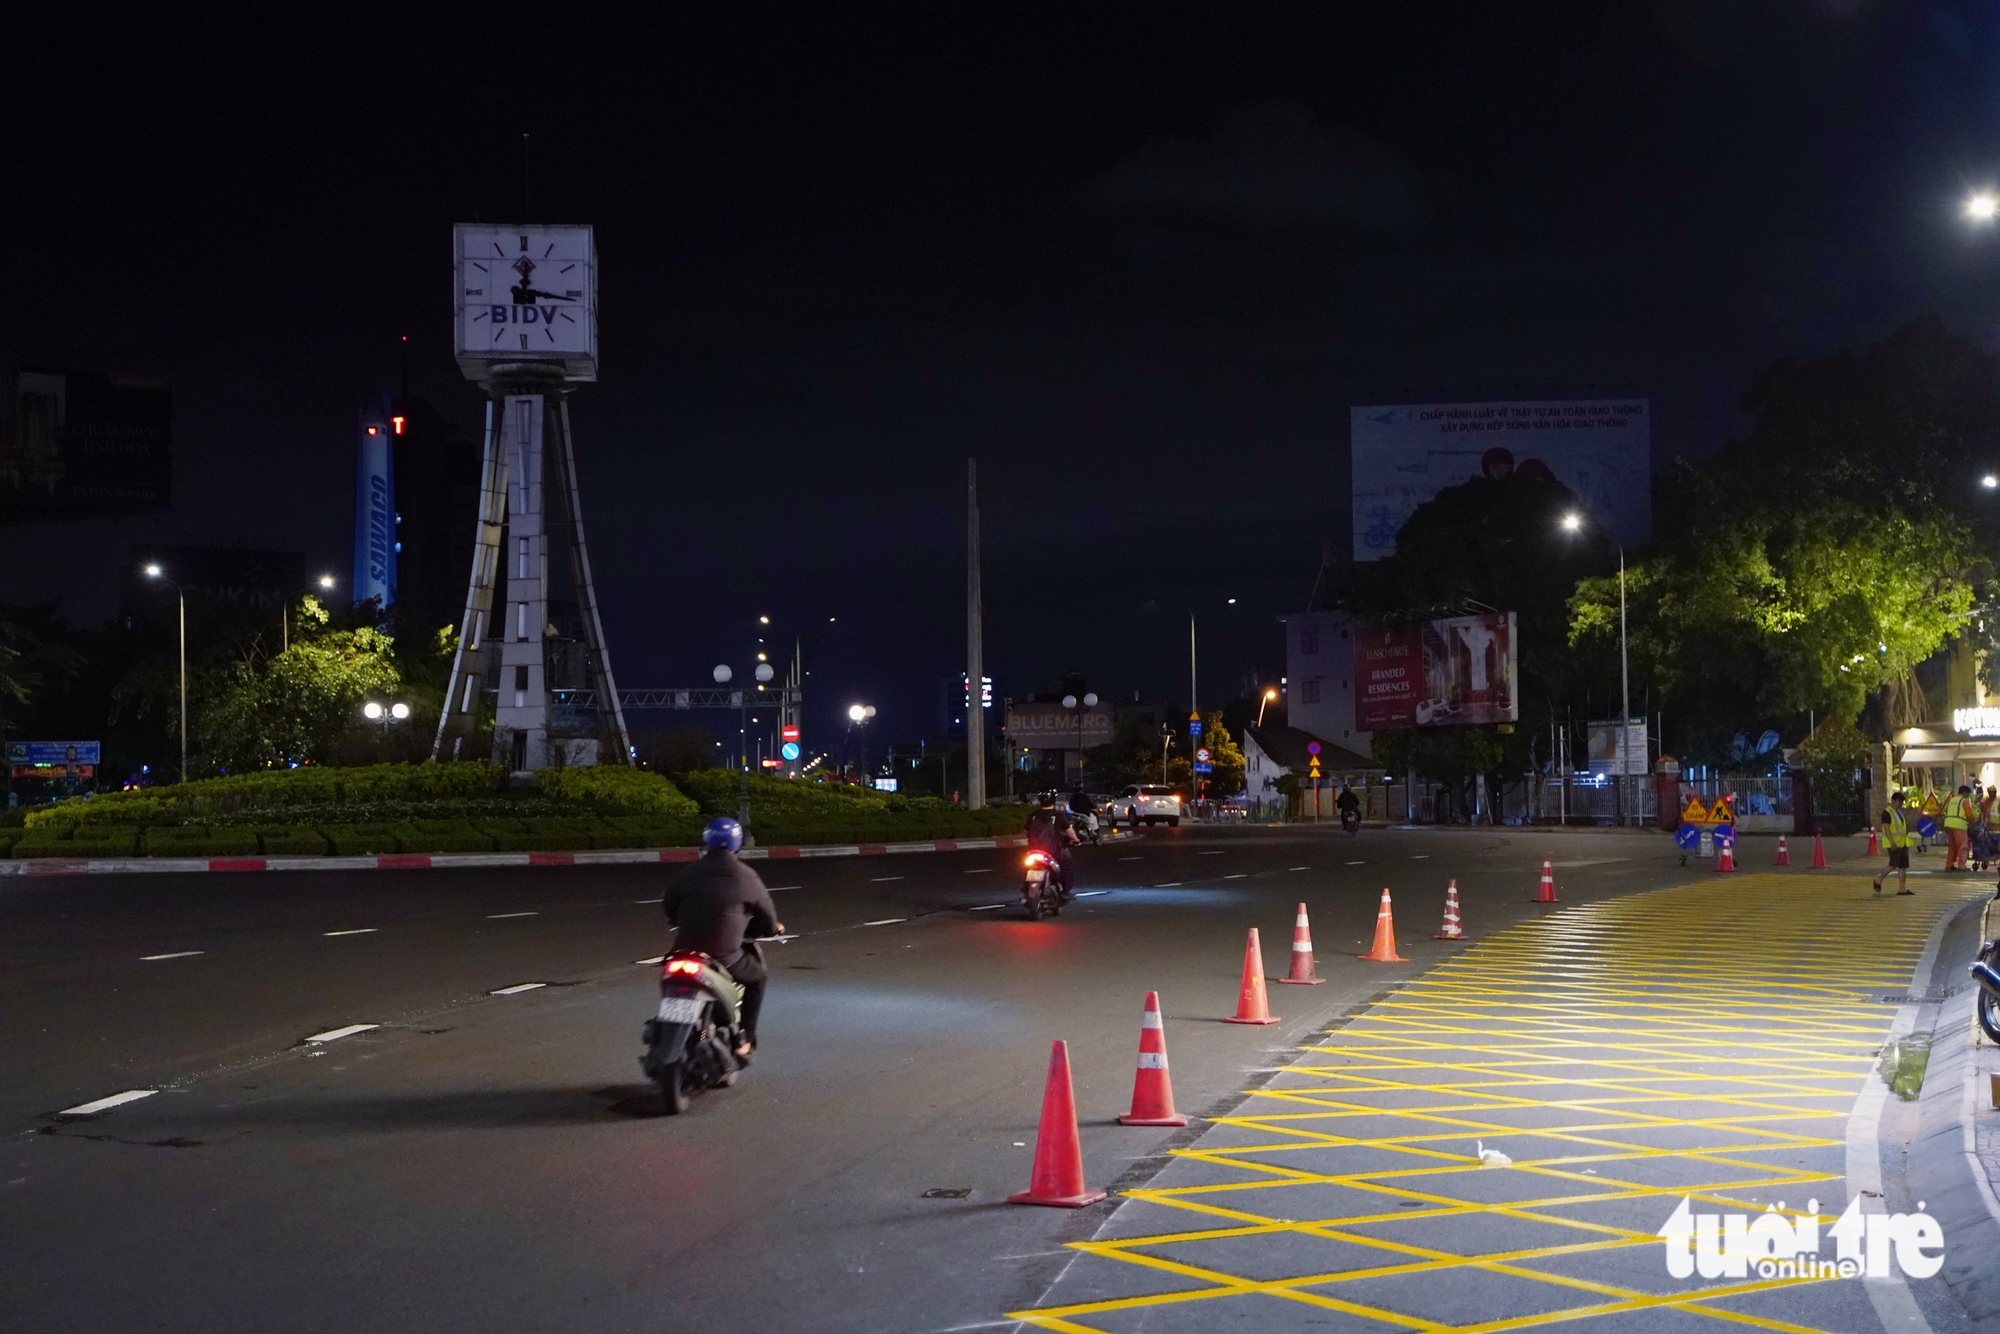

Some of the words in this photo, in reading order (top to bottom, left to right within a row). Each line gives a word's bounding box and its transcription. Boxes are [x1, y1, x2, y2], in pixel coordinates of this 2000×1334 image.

[491, 305, 557, 325] BIDV
[1548, 407, 1560, 417] AN
[1588, 406, 1610, 416] GIAO
[1612, 404, 1643, 415] THÔNG
[1573, 418, 1595, 429] GIAO
[1597, 417, 1628, 428] THÔNG
[370, 474, 388, 586] SAWACO
[1371, 667, 1405, 679] BRANDED
[1368, 681, 1409, 694] RESIDENCES
[1011, 713, 1109, 731] BLUEMARQ
